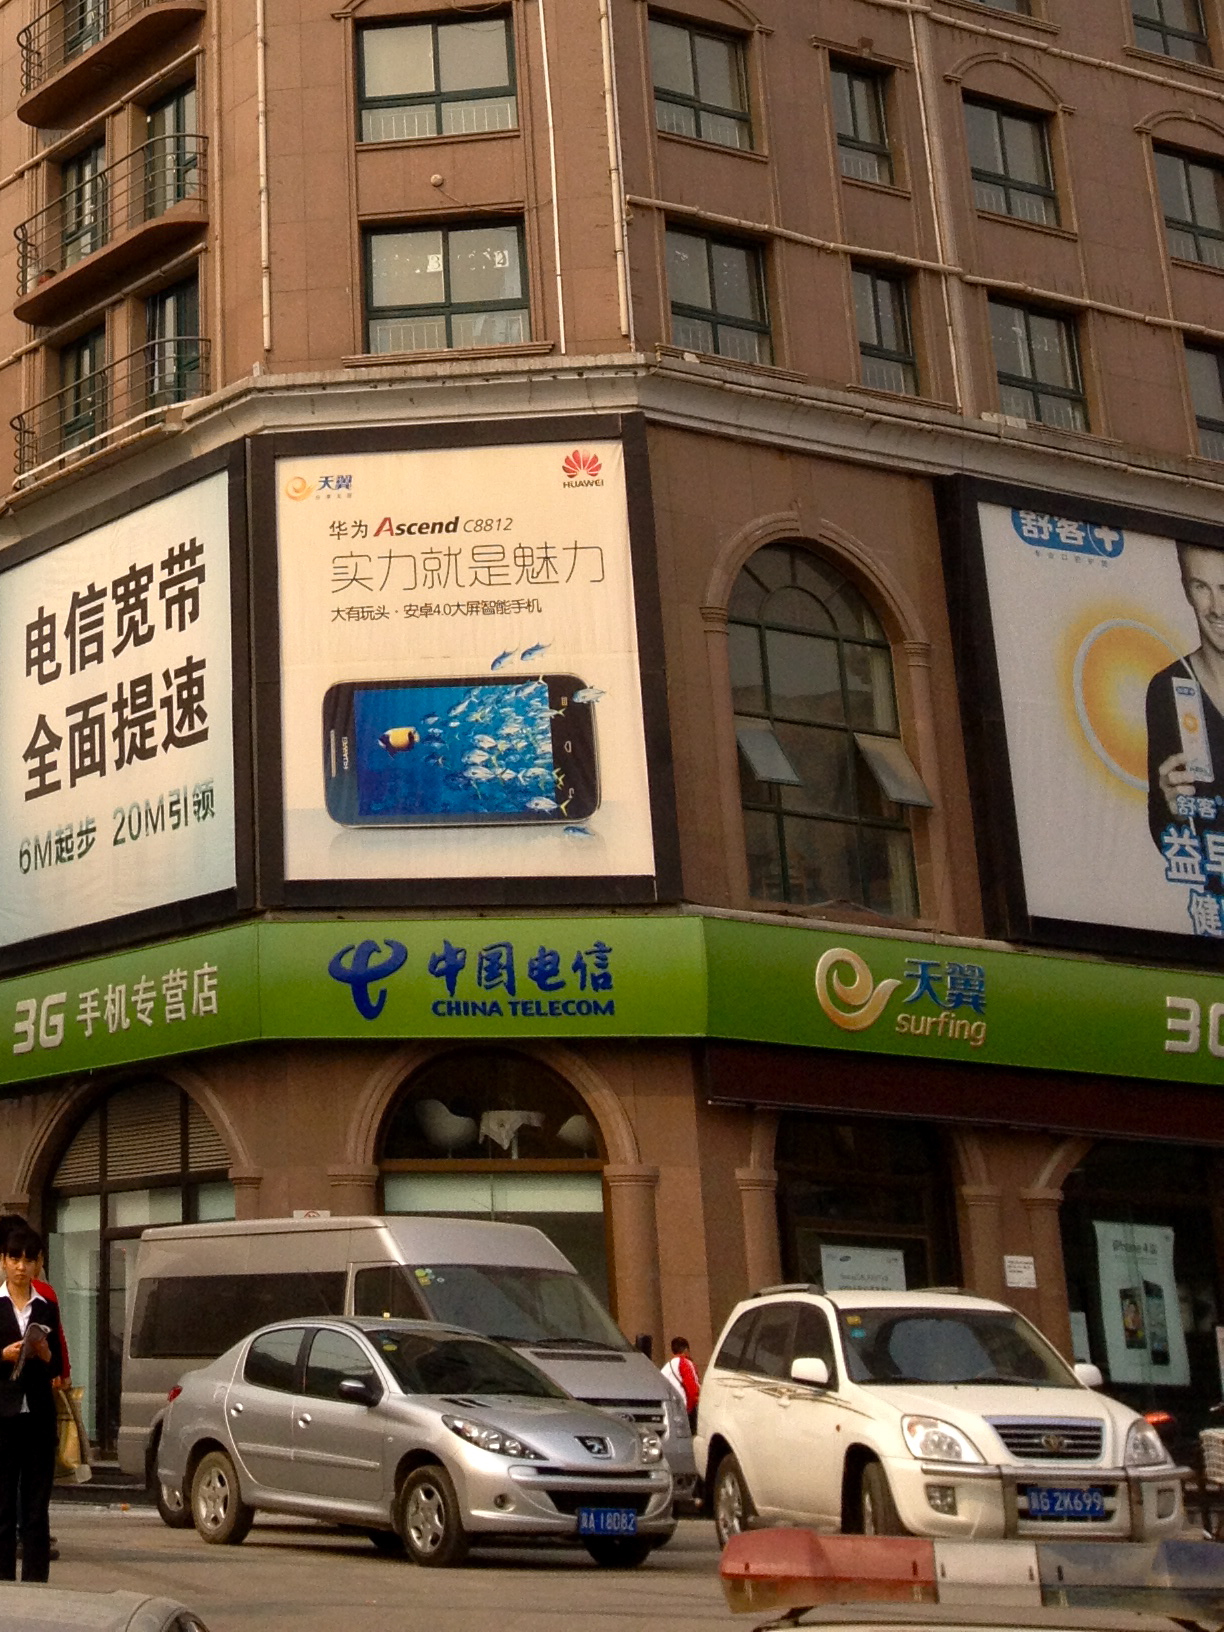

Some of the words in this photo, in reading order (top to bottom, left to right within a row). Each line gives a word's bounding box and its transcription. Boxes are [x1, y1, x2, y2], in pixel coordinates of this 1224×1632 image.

[317, 474, 352, 491] 天翼
[563, 479, 604, 488] HUAWEI
[329, 520, 368, 540] 华为
[373, 516, 460, 537] Ascend
[463, 518, 513, 533] C8812
[331, 540, 604, 593] 实力就是魅力
[25, 536, 206, 686] 电信宽带
[23, 655, 209, 802] 全面提速
[18, 815, 96, 875] 6M起步
[112, 778, 215, 847] 20M引领
[428, 939, 614, 997] 中国电信
[902, 958, 987, 1014] 天翼
[13, 992, 67, 1055] 3G
[76, 962, 218, 1038] 手机专营店
[431, 999, 503, 1017] CHINA
[508, 999, 615, 1017] TELECOM
[896, 1011, 986, 1048] surfing
